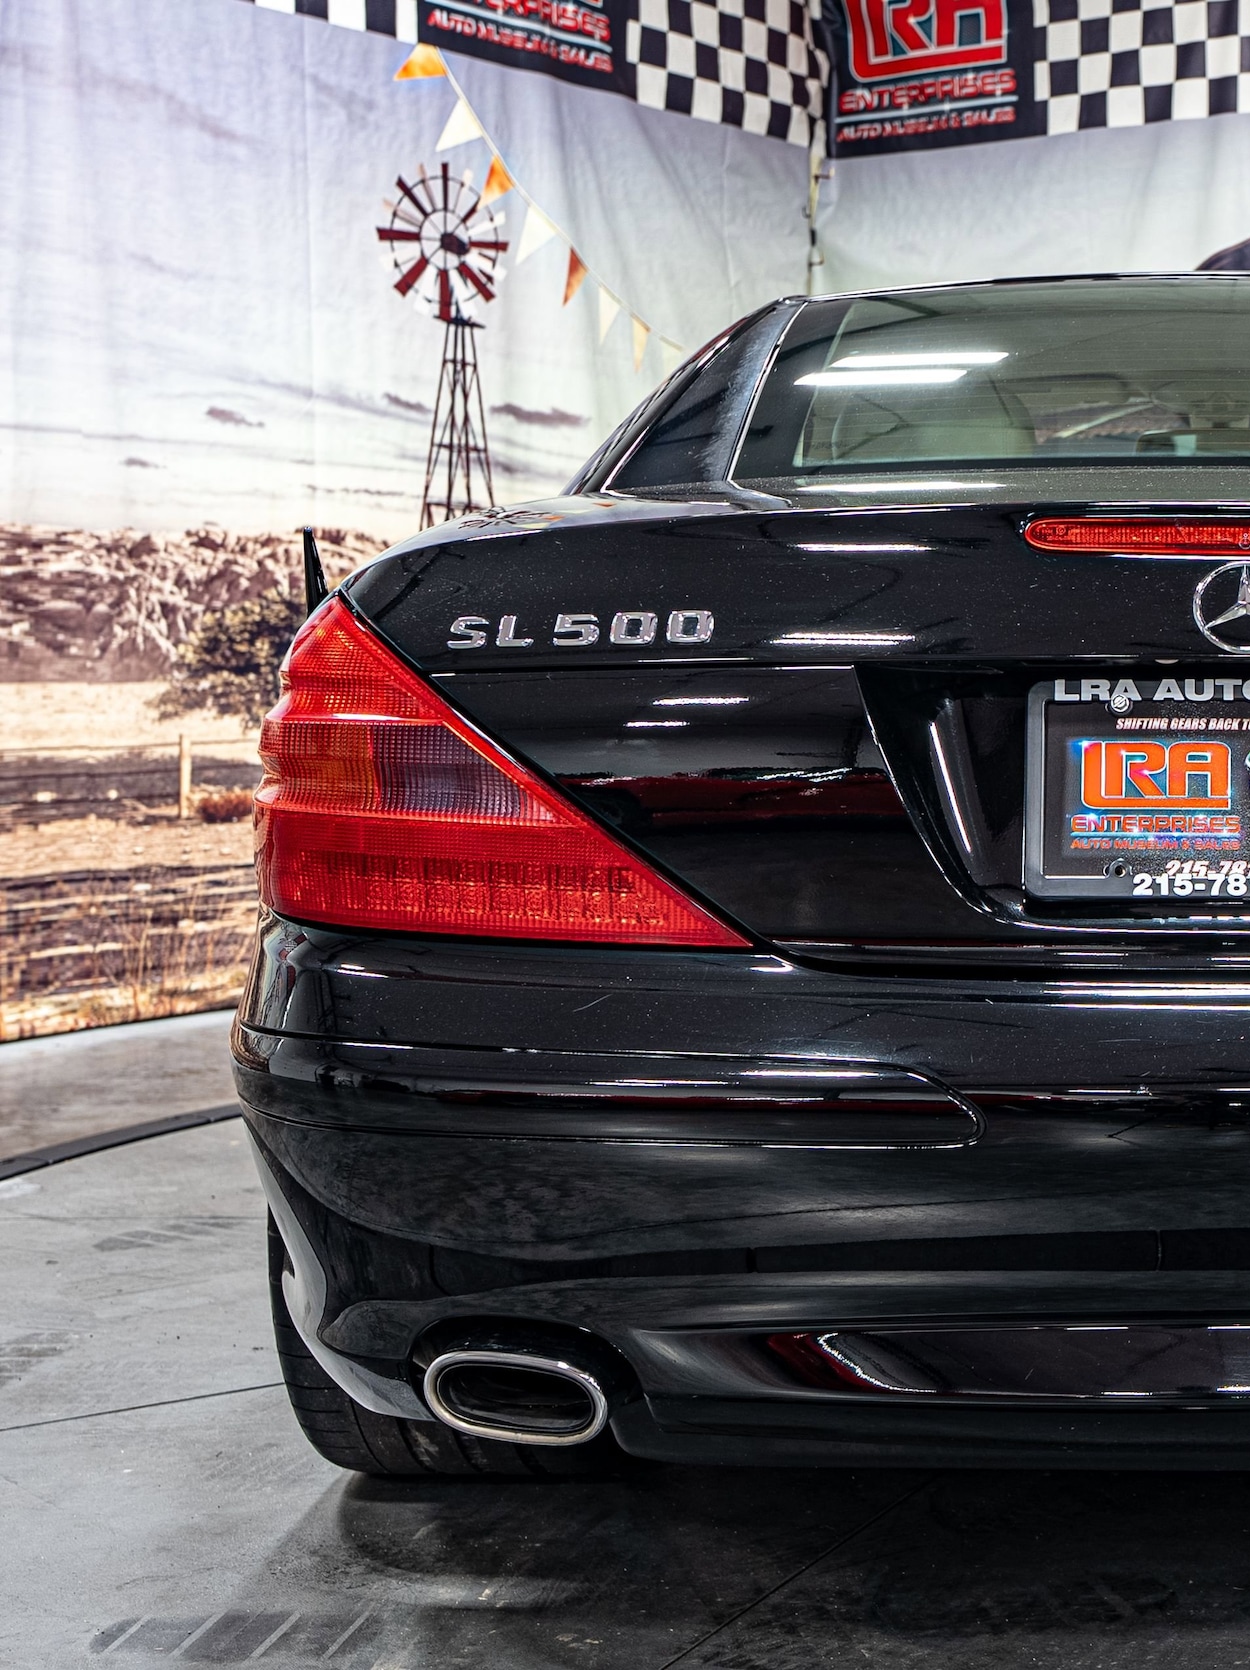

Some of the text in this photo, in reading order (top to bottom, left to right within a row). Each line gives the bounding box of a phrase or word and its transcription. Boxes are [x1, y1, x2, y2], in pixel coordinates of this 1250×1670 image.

[427, 8, 477, 37] AUTO
[838, 68, 1017, 113] ENTERPRISES
[837, 121, 882, 143] AUTO
[447, 609, 714, 648] SL 500
[1054, 679, 1142, 701] LRA
[1115, 717, 1169, 731] SHIFTING
[1170, 718, 1205, 731] GEARS
[1208, 718, 1241, 731] BACK
[1081, 741, 1231, 810] LRA
[1070, 814, 1242, 834] ENTERPRISES
[1070, 838, 1111, 850] AUTO
[1114, 838, 1178, 850] MUSEUM
[1194, 838, 1242, 850] SALES
